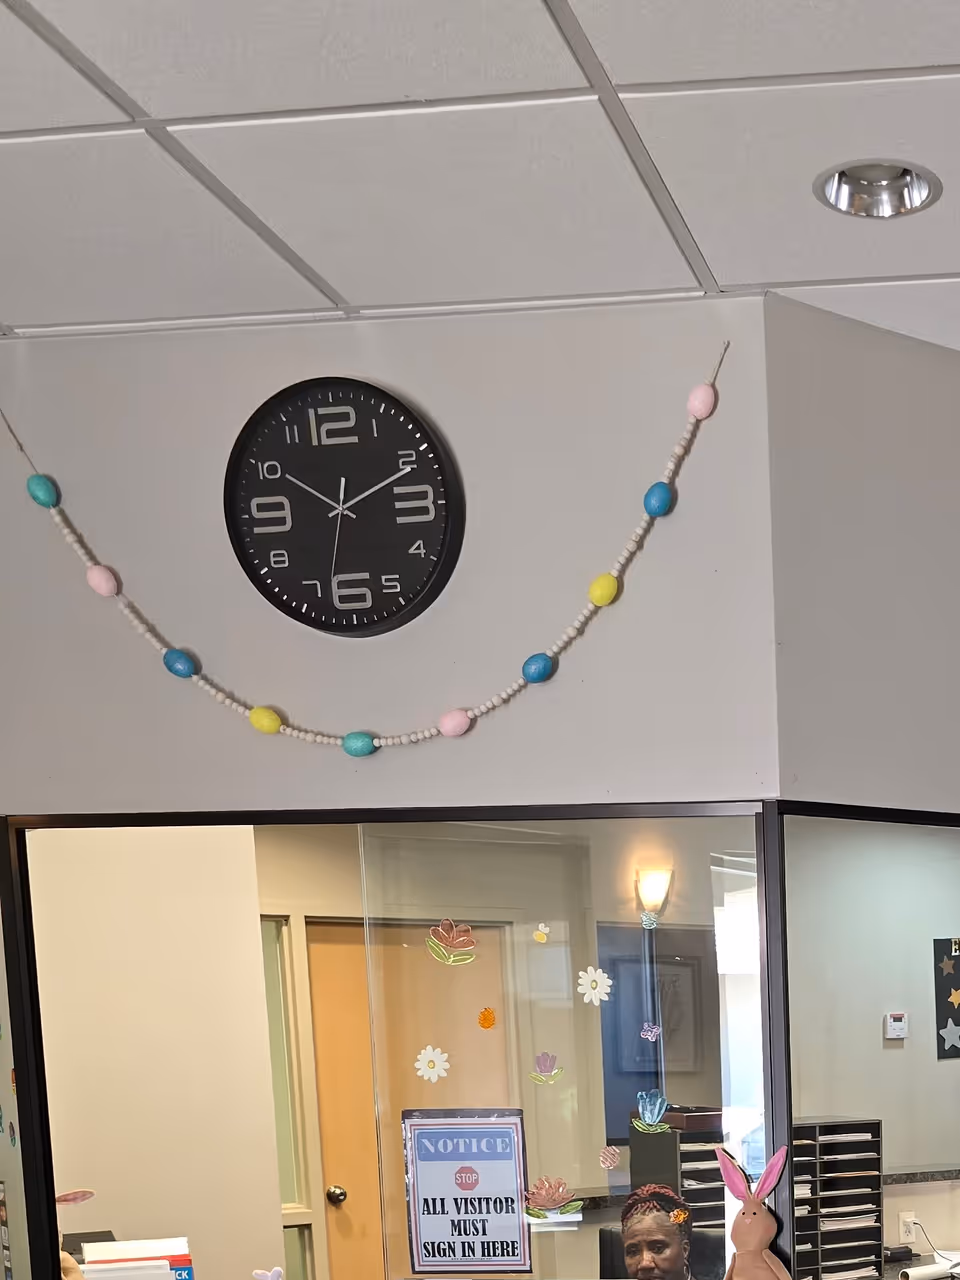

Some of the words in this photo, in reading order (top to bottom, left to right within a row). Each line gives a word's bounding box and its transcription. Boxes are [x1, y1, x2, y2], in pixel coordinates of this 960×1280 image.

[285, 424, 299, 444] 11
[308, 405, 359, 446] 12
[371, 418, 378, 438] 1
[397, 450, 417, 469] 2
[257, 460, 282, 480] 10
[393, 484, 436, 524] 3
[250, 495, 293, 534] 9
[408, 540, 426, 558] 4
[269, 550, 289, 568] 8
[302, 580, 322, 598] 7
[331, 572, 373, 610] 6
[381, 574, 401, 593] 5
[420, 1137, 511, 1154] NOTICE
[455, 1173, 478, 1184] STOP
[422, 1197, 449, 1216] ALL
[453, 1196, 516, 1215] VISITOR
[450, 1219, 489, 1237] MUST
[423, 1241, 456, 1258] SIGN
[460, 1241, 477, 1258] IN
[480, 1240, 519, 1258] HERE
